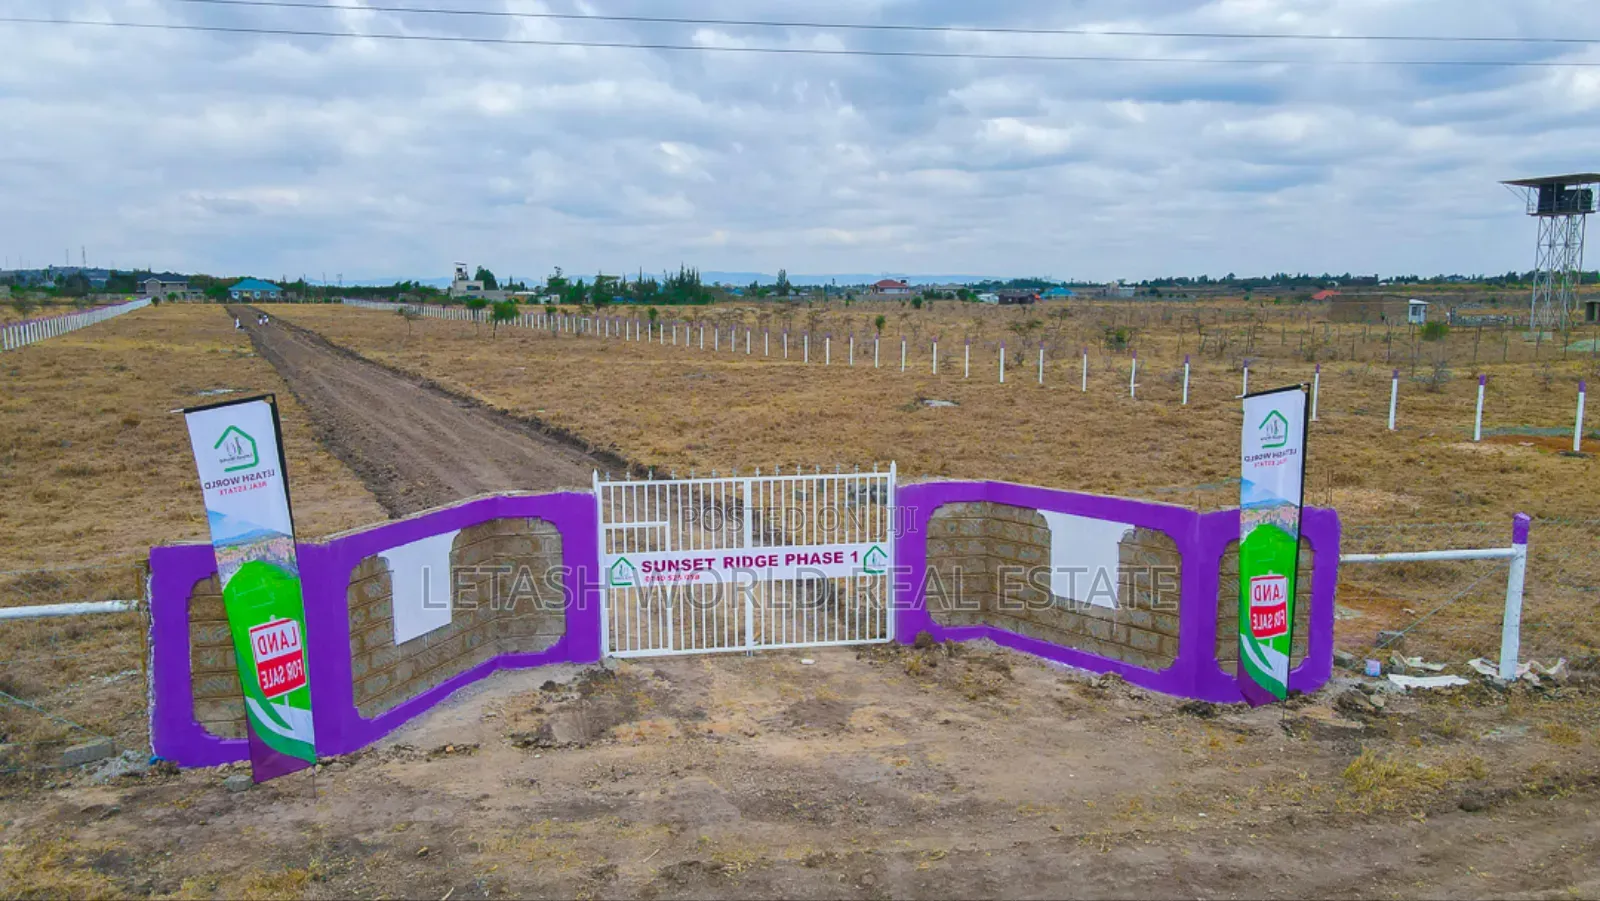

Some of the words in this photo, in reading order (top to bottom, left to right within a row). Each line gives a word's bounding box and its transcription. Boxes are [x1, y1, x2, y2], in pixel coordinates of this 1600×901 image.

[641, 557, 716, 573] SUNSET
[723, 554, 779, 569] RIDGE
[785, 551, 844, 566] PHASE
[850, 551, 858, 563] 1
